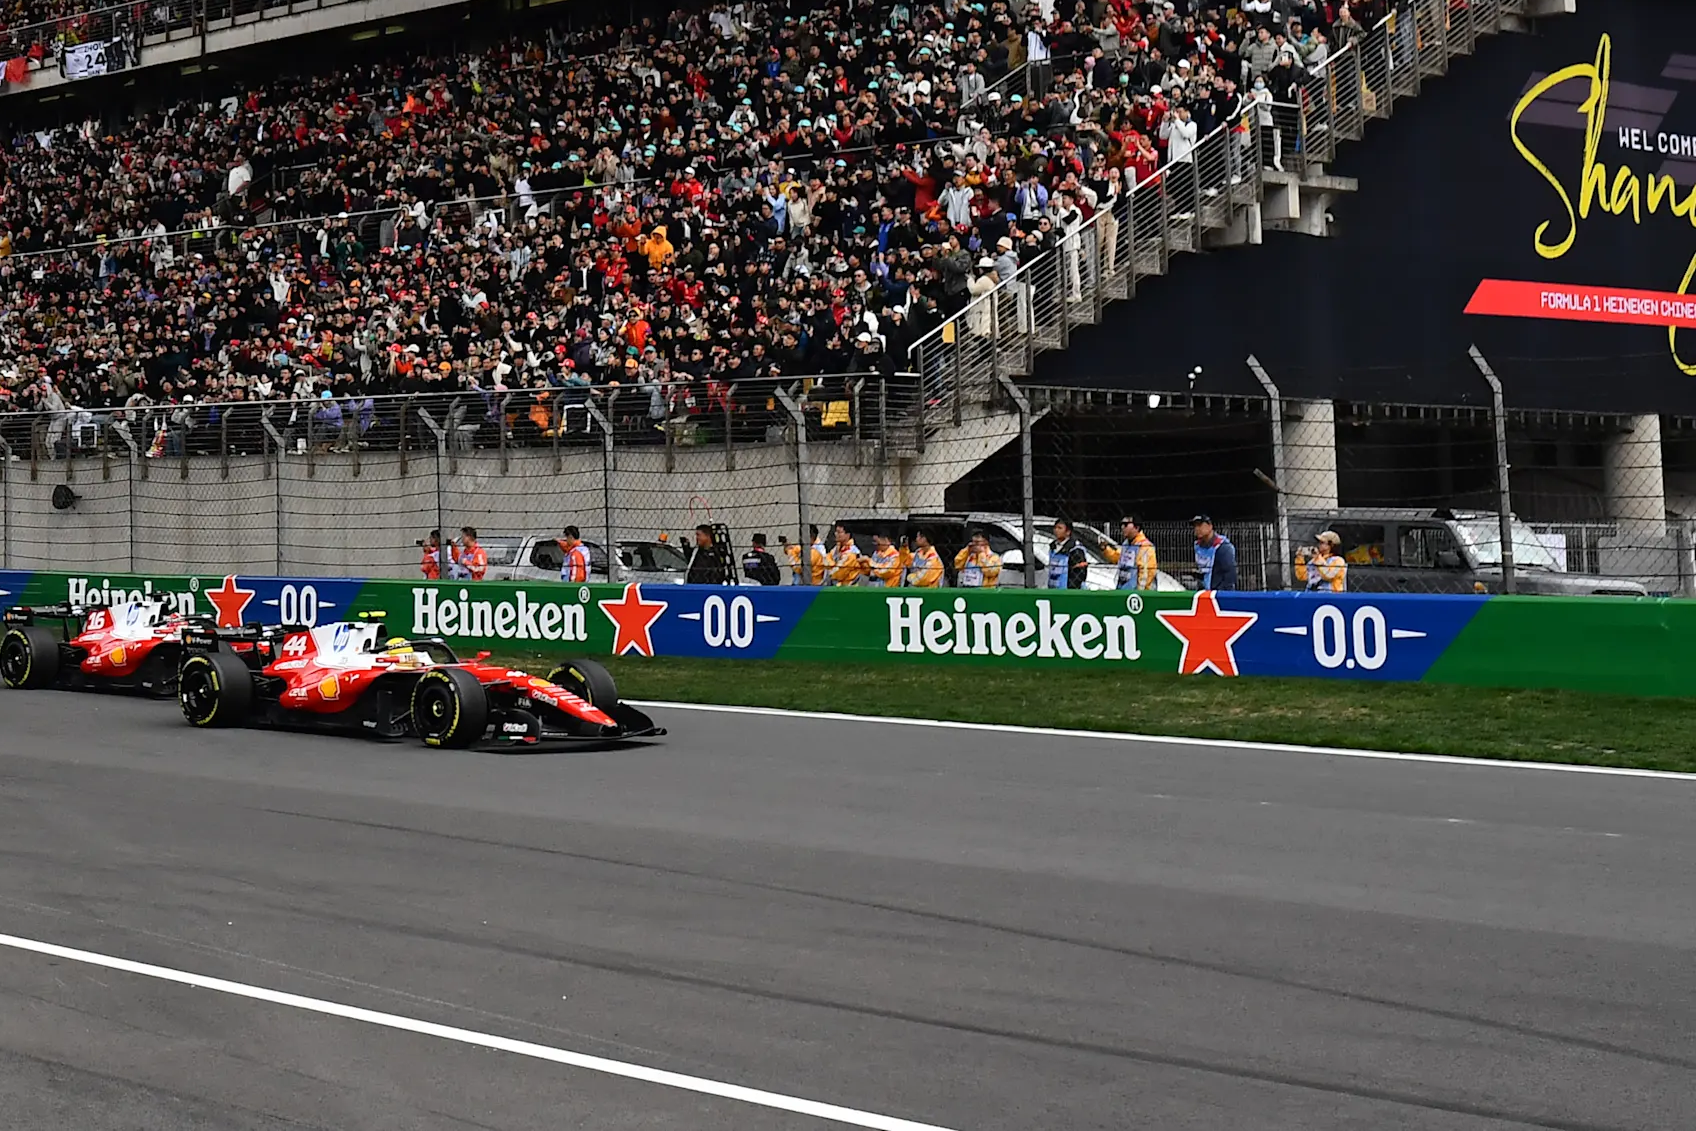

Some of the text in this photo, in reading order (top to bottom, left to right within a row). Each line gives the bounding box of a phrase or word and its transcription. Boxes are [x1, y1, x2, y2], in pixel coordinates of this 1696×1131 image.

[85, 52, 107, 69] 24
[1540, 291, 1591, 311] FORMULA
[1593, 295, 1601, 312] 1
[1603, 296, 1658, 316] HEINEKEN
[280, 584, 318, 628] 0.0
[411, 587, 754, 649] Heineken 0.0
[87, 611, 105, 630] 16
[283, 635, 308, 656] 44
[886, 596, 1387, 671] Heineken 0.0
